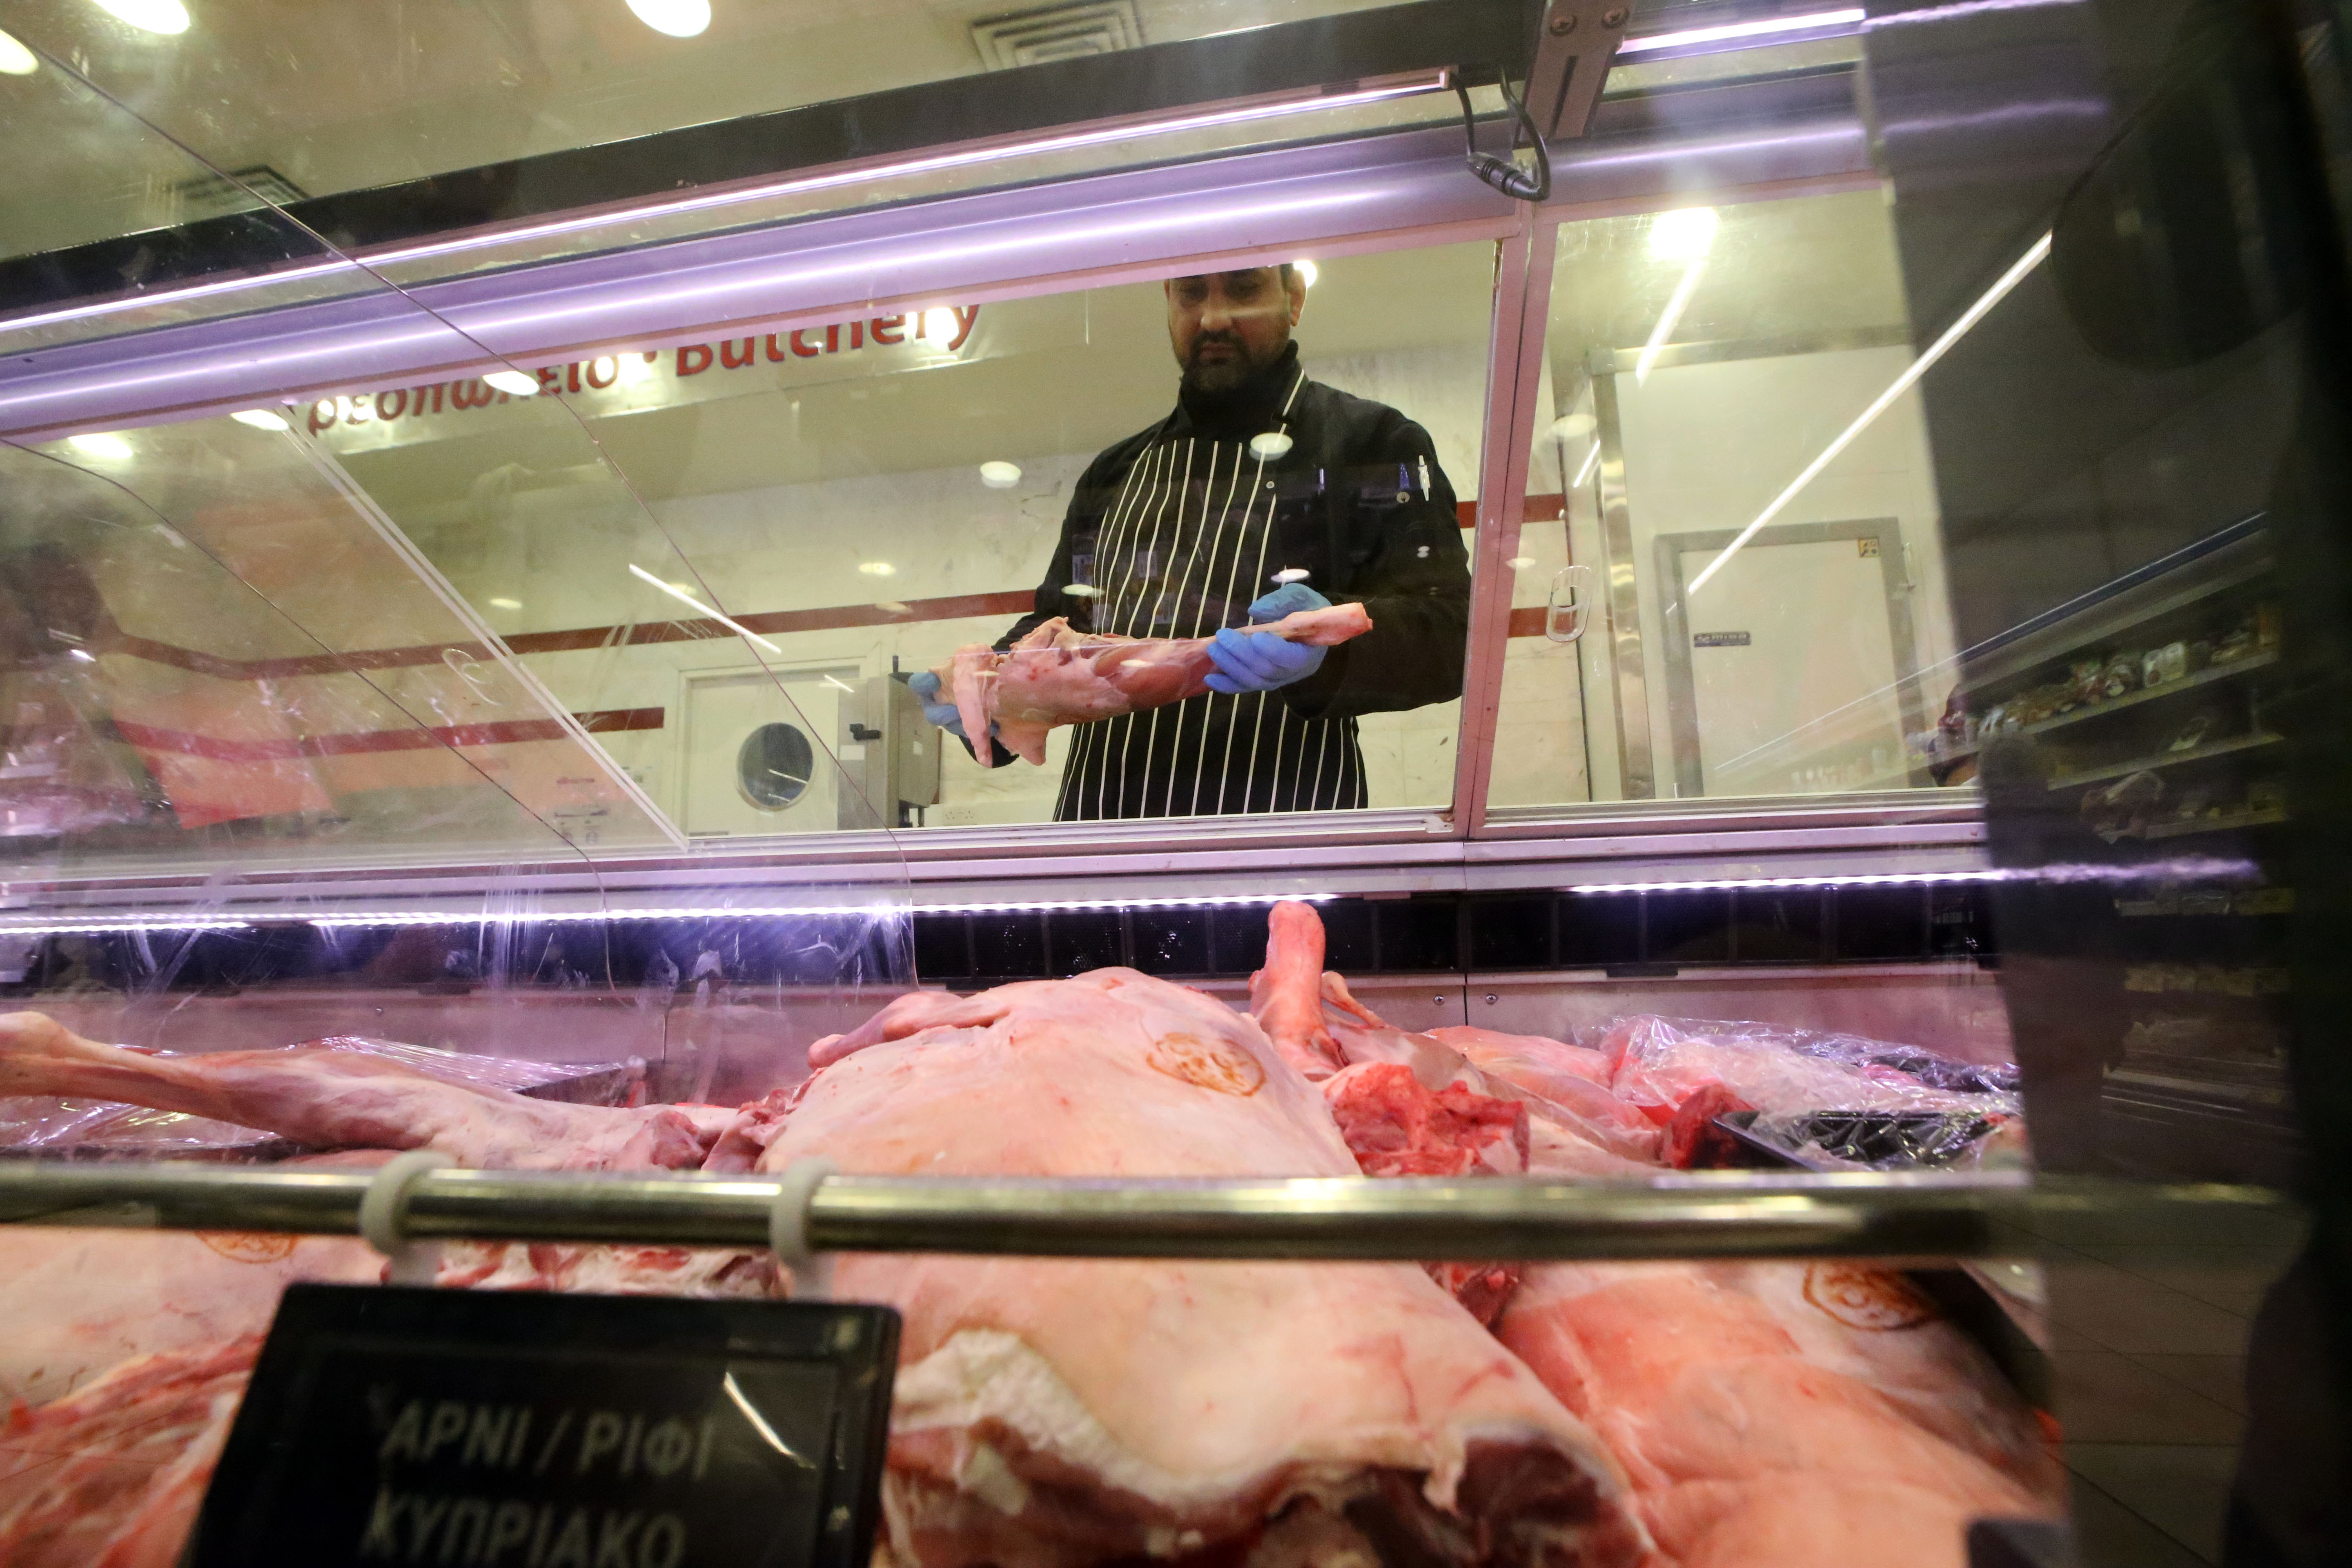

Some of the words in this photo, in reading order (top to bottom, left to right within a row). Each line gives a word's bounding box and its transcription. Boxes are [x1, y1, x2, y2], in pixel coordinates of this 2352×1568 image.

[378, 1399, 533, 1467] ΑΡΝΙ
[578, 1411, 714, 1482] ΡΙΦΙ
[358, 1492, 685, 1568] ΚΥΠΡΙΑΚΟ
